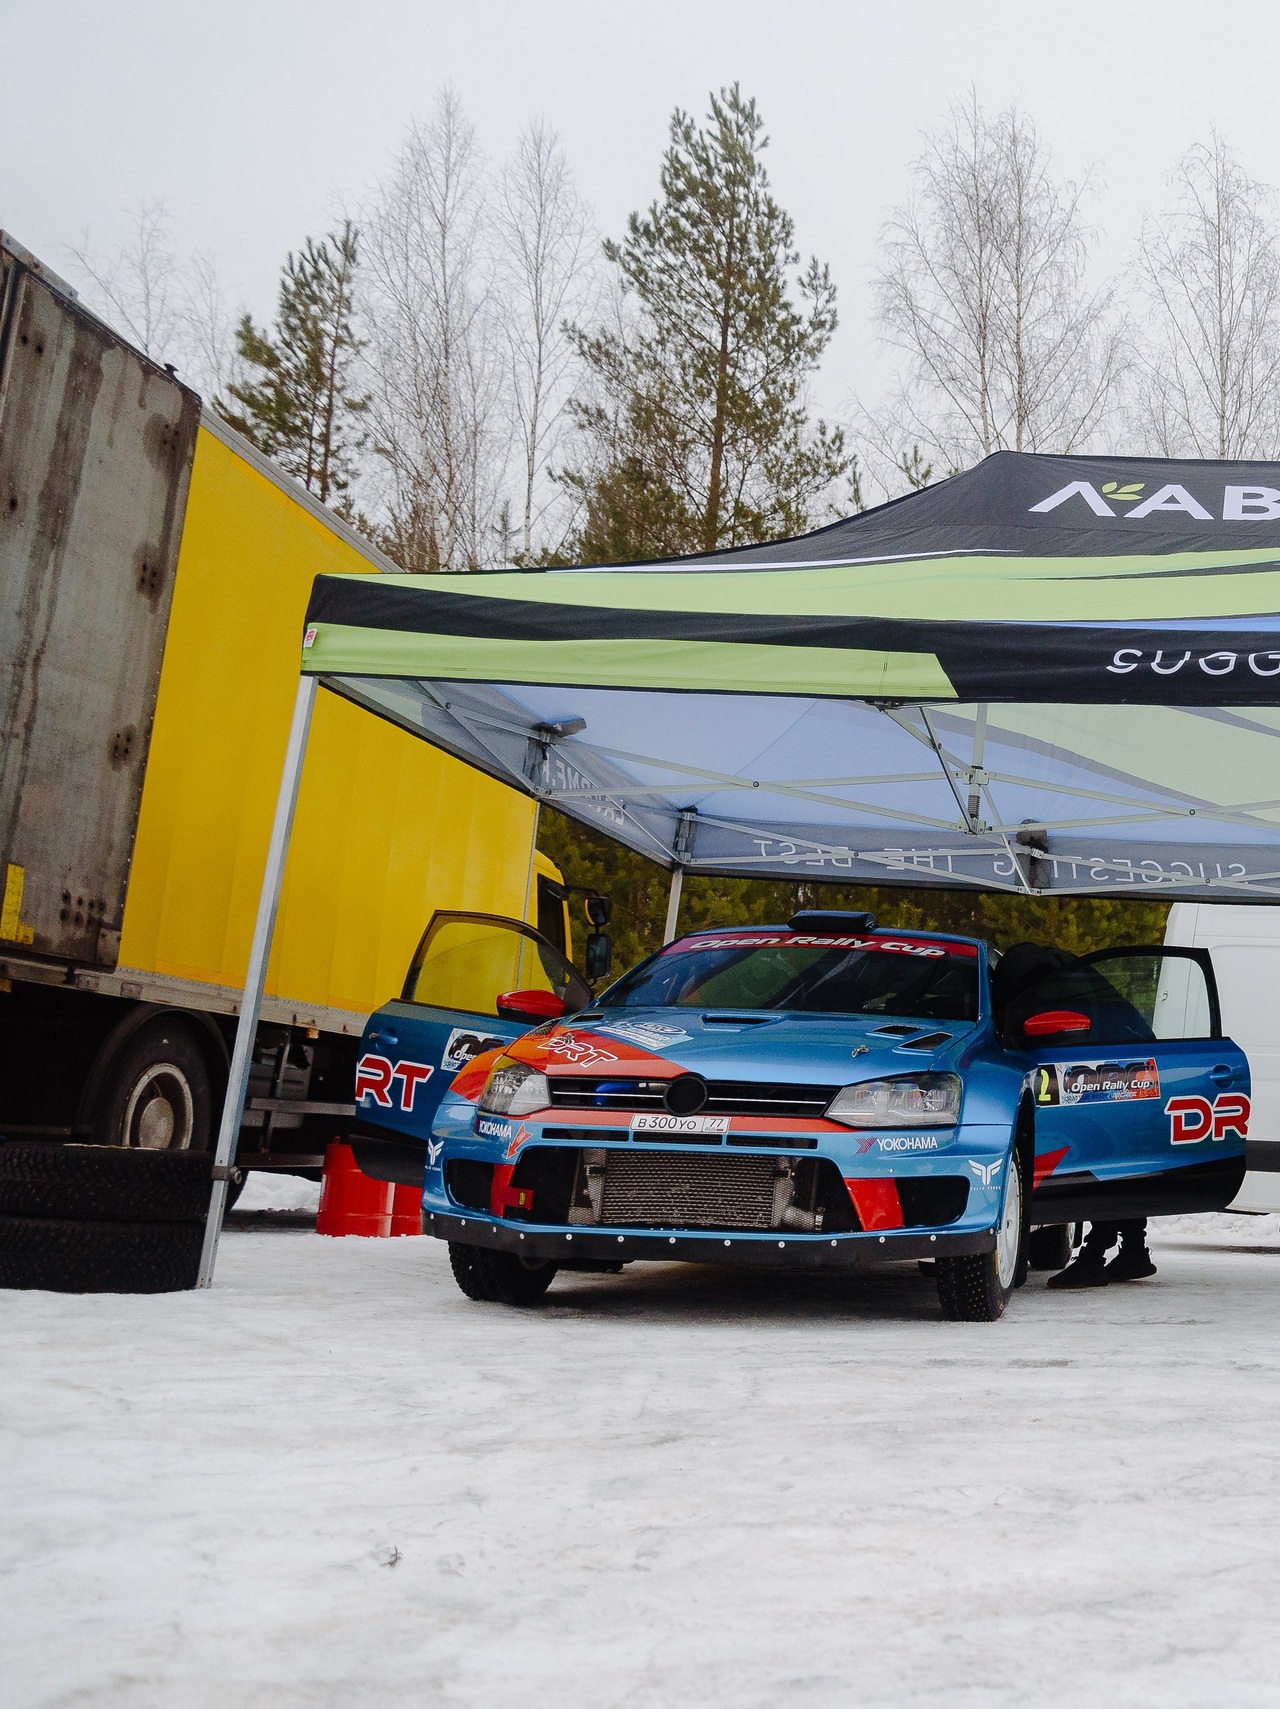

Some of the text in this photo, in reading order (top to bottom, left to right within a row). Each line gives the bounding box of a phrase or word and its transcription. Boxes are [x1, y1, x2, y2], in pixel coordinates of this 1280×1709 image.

[690, 936, 946, 958] Open Rally Cup
[1038, 1069, 1051, 1101] 2
[1071, 1080, 1150, 1093] Open Rally Cup
[479, 1119, 512, 1138] YOKOHAMA
[709, 1118, 724, 1128] 77
[876, 1136, 939, 1151] YOKOHAMA
